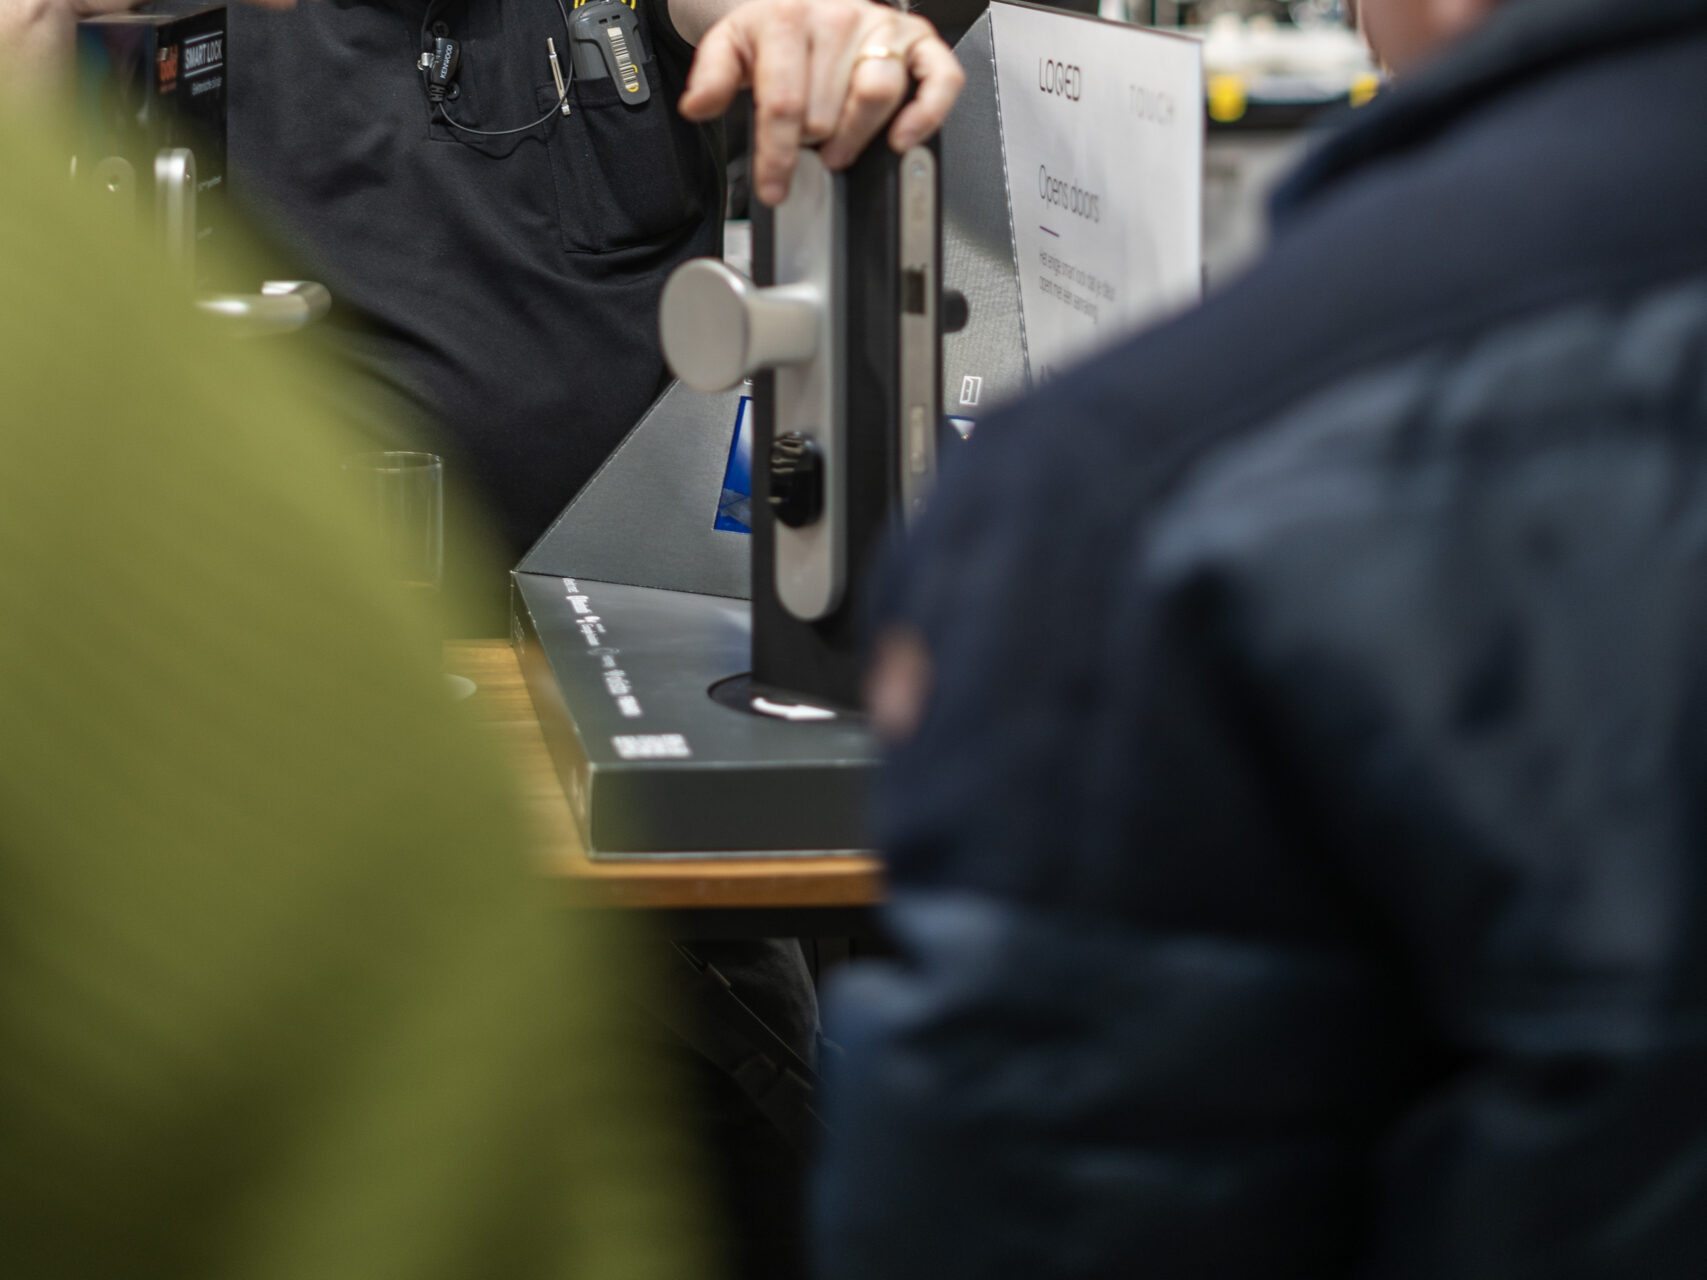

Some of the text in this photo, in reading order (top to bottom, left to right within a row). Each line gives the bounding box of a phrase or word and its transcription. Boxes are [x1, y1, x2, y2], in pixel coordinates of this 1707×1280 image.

[206, 40, 222, 63] LOCK
[440, 44, 453, 79] KENWOOD
[1039, 57, 1081, 102] LOQED
[1039, 164, 1100, 223] Opens doors
